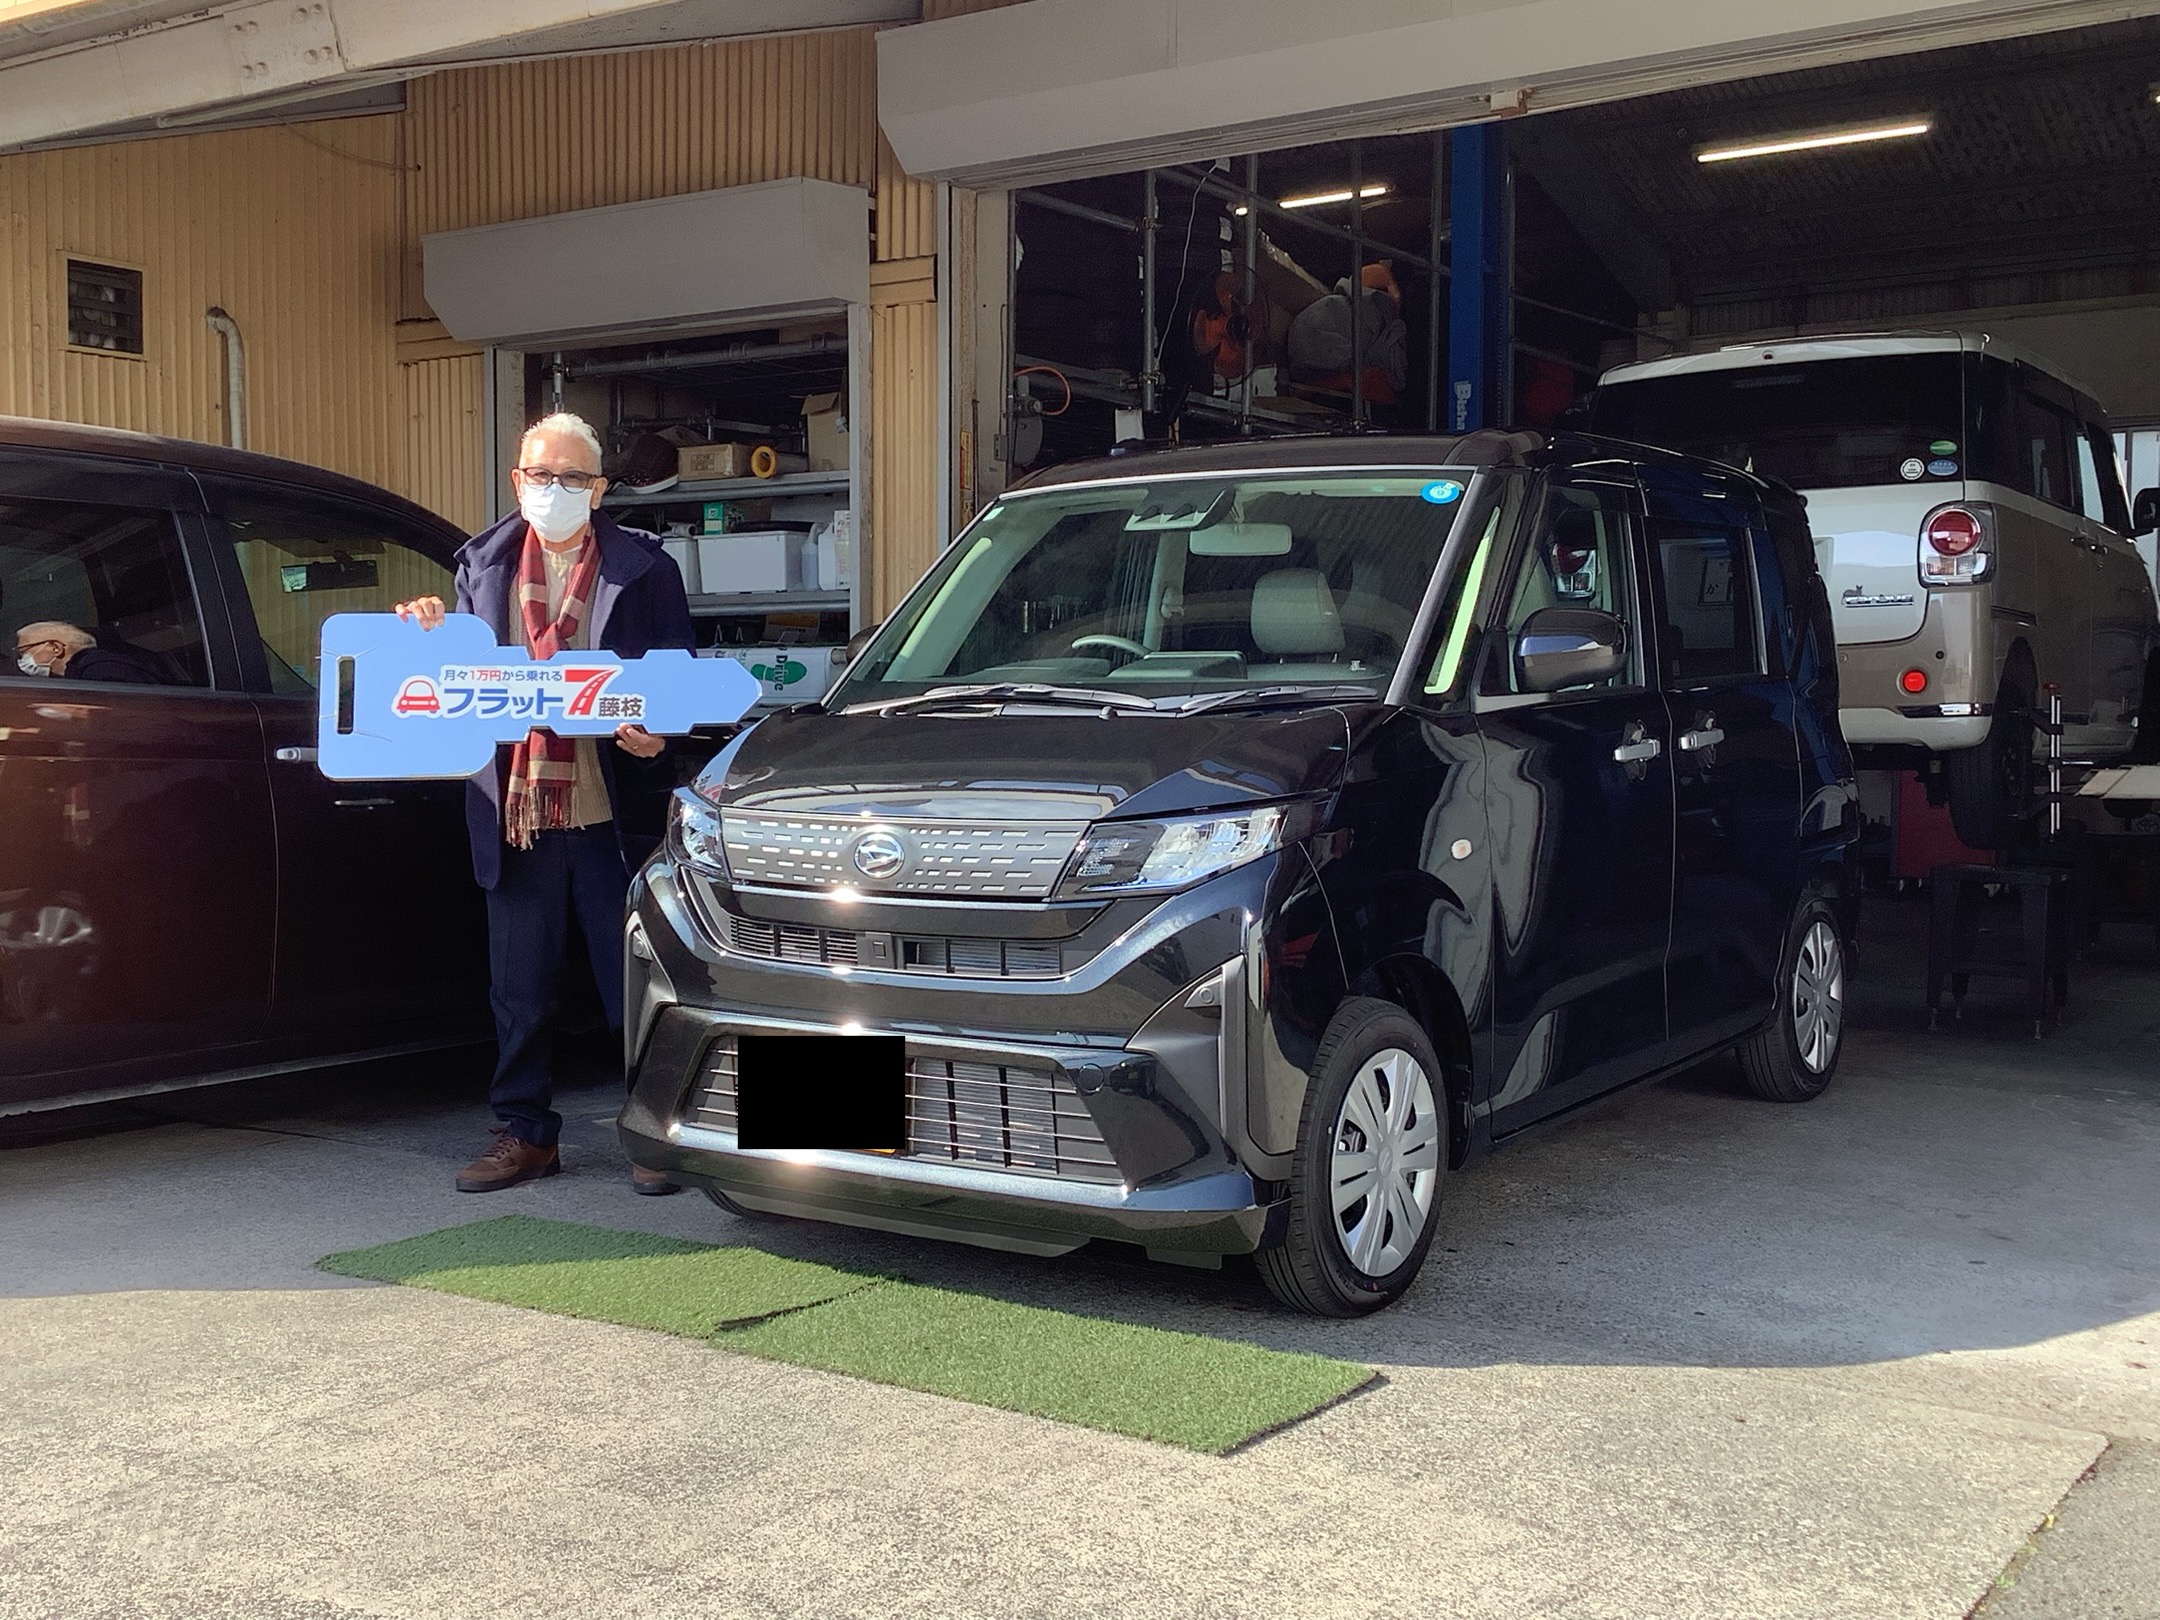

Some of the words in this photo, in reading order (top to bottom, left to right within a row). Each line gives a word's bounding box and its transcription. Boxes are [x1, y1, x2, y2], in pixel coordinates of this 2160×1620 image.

[444, 669, 563, 682] 月々1万円から乗れる
[774, 655, 788, 691] Drive
